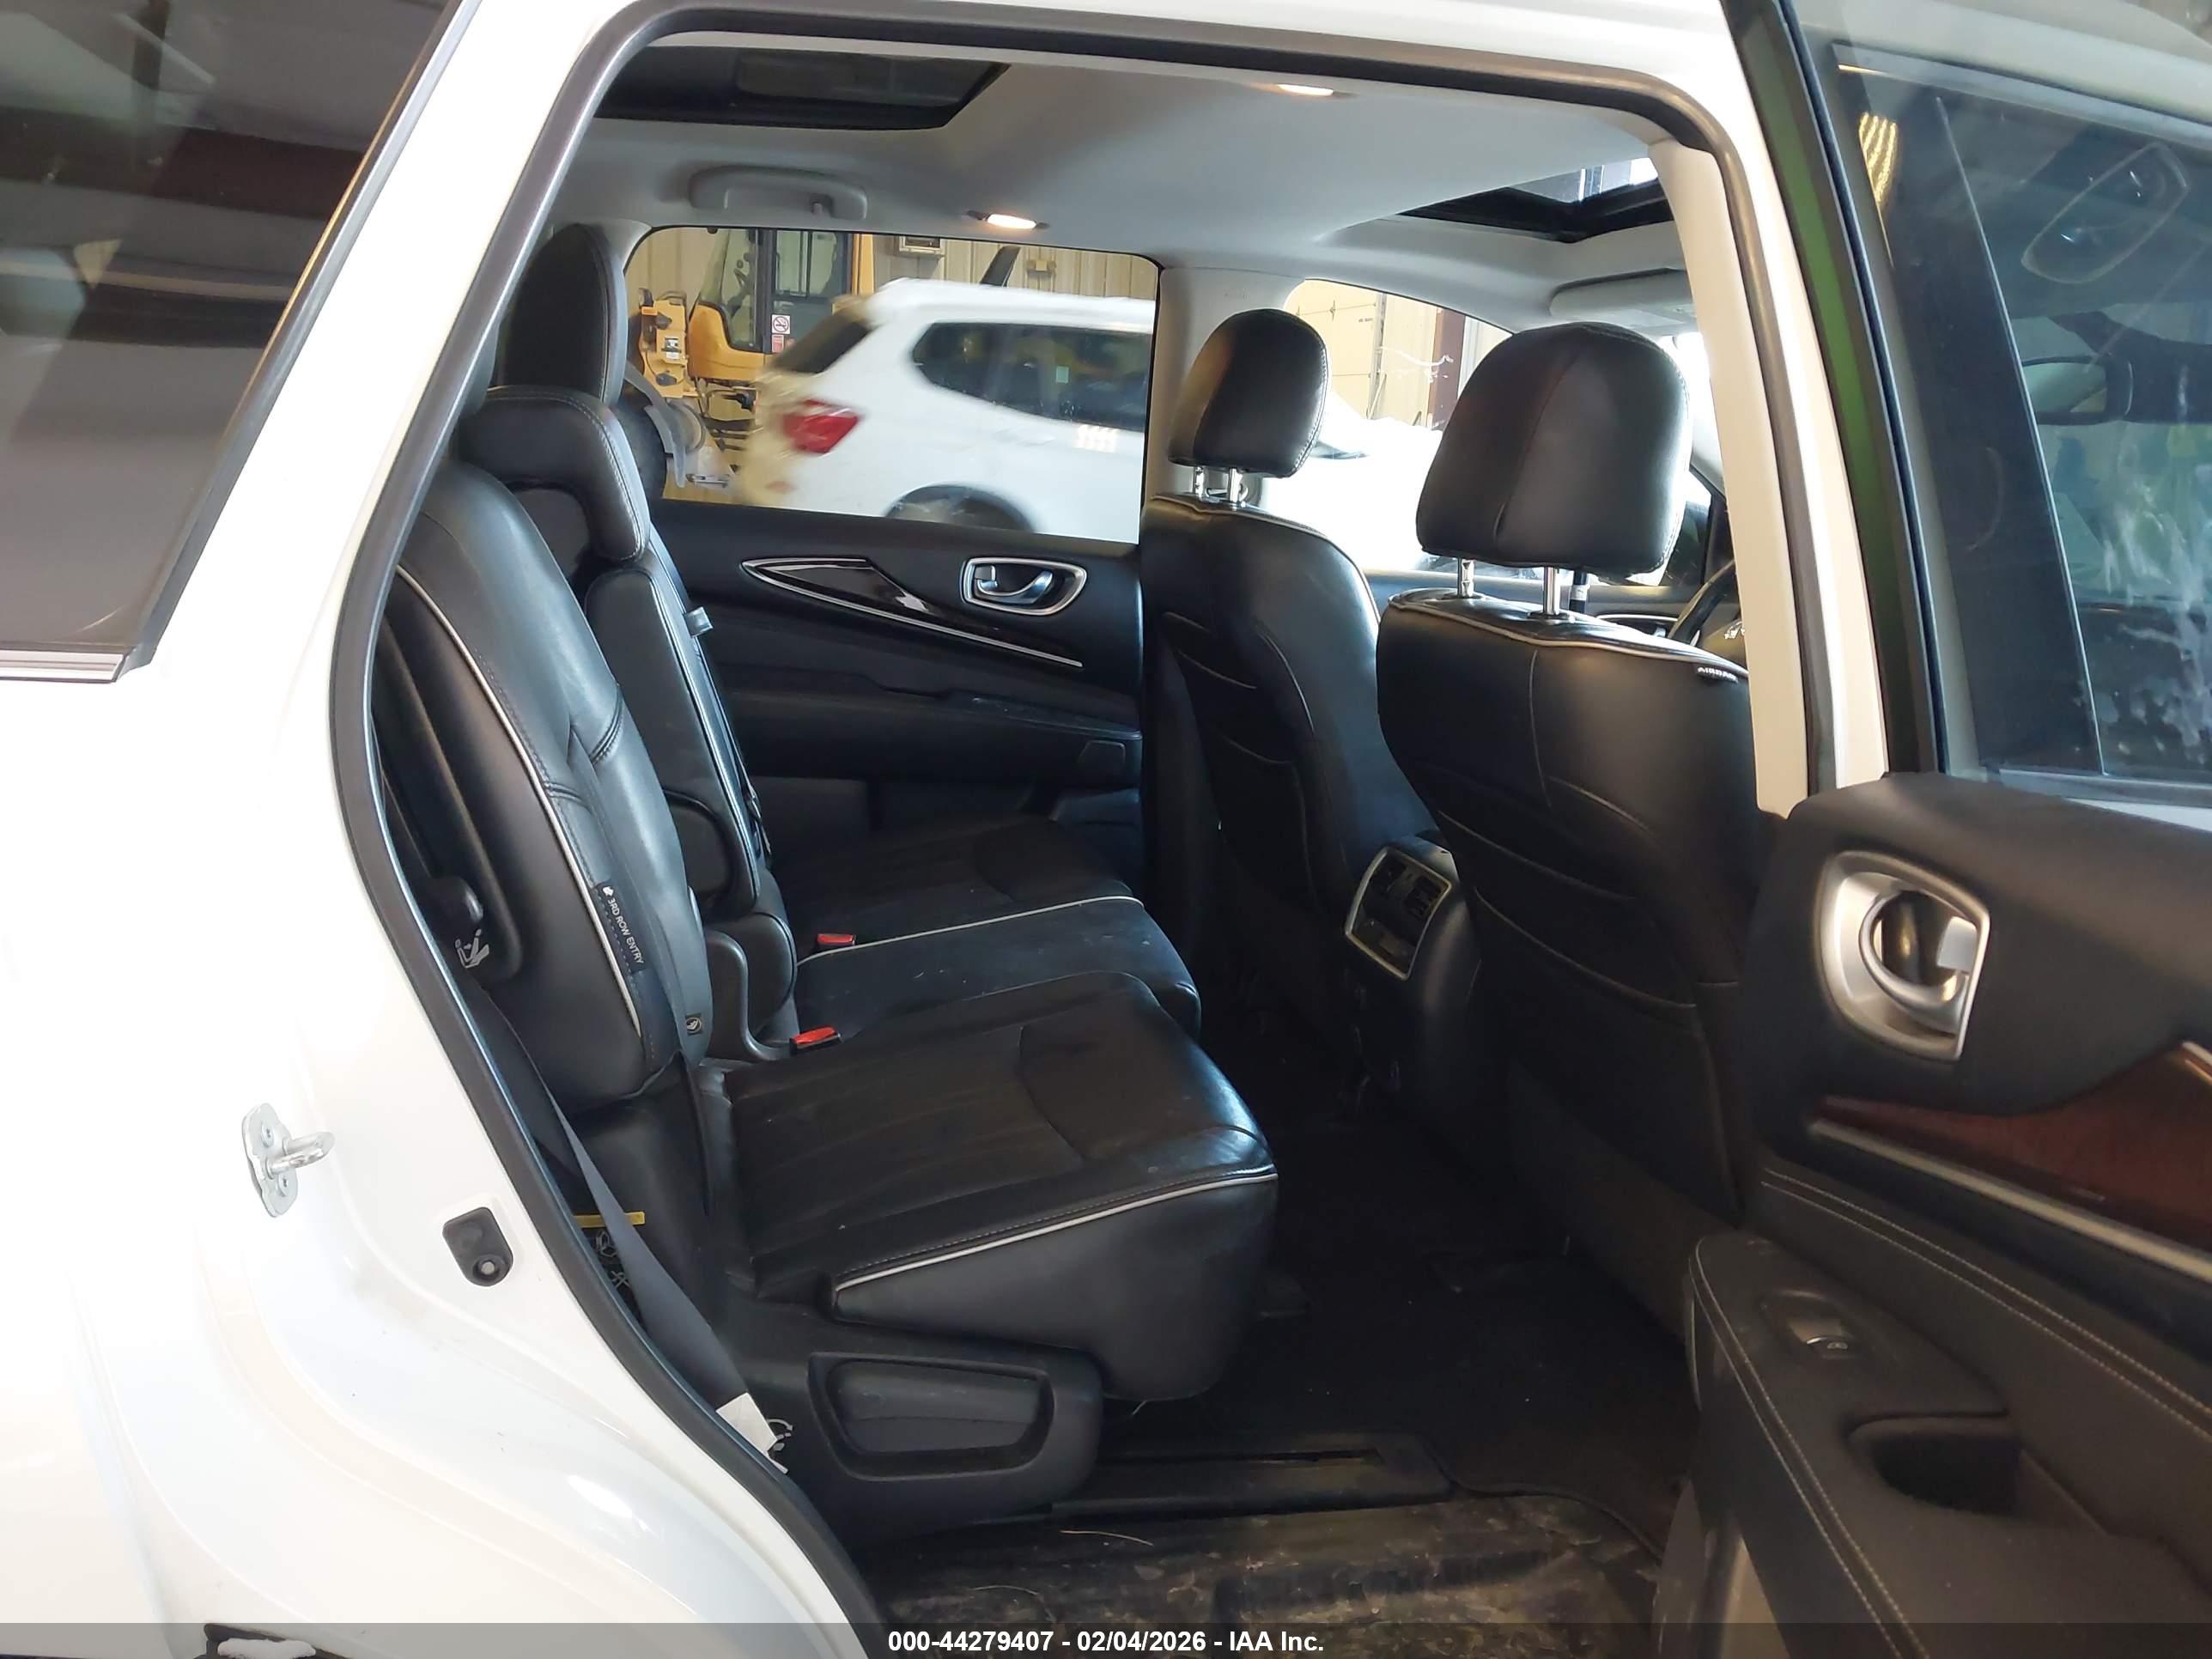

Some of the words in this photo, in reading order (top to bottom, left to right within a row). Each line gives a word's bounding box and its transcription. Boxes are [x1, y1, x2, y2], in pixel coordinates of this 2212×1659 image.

[607, 897, 620, 915] 3RD
[616, 915, 631, 935] ROW
[626, 937, 644, 963] ENTRY
